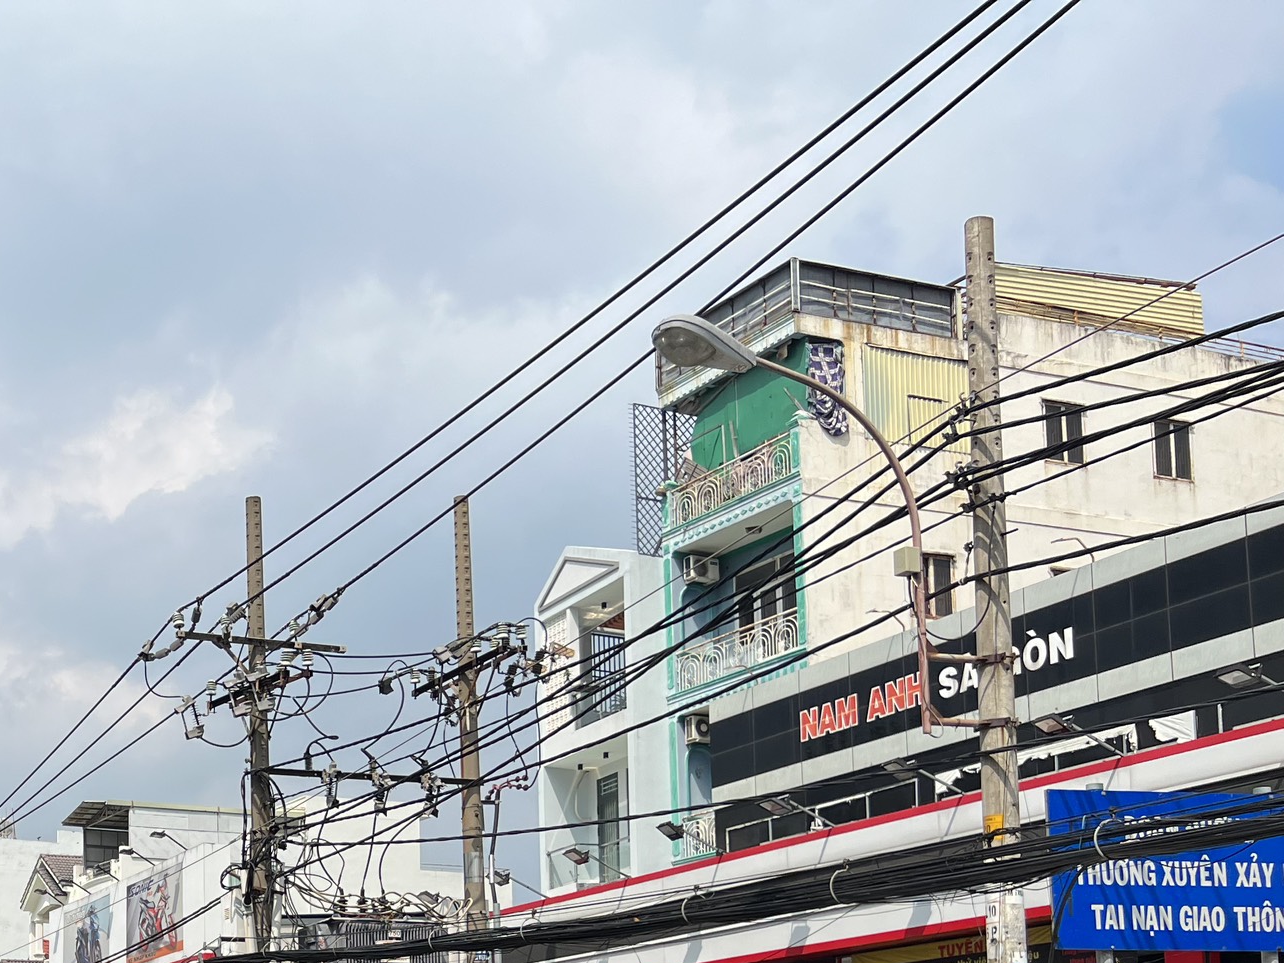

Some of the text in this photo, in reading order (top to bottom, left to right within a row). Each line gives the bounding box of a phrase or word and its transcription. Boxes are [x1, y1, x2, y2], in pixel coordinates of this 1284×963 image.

[799, 692, 859, 743] NAM
[866, 670, 922, 723] ANH
[1161, 853, 1228, 888] XUYÊN
[1236, 852, 1275, 888] XẢY
[1091, 903, 1125, 931] TAI
[1132, 904, 1173, 937] NẠN
[1179, 904, 1226, 932] GIAO
